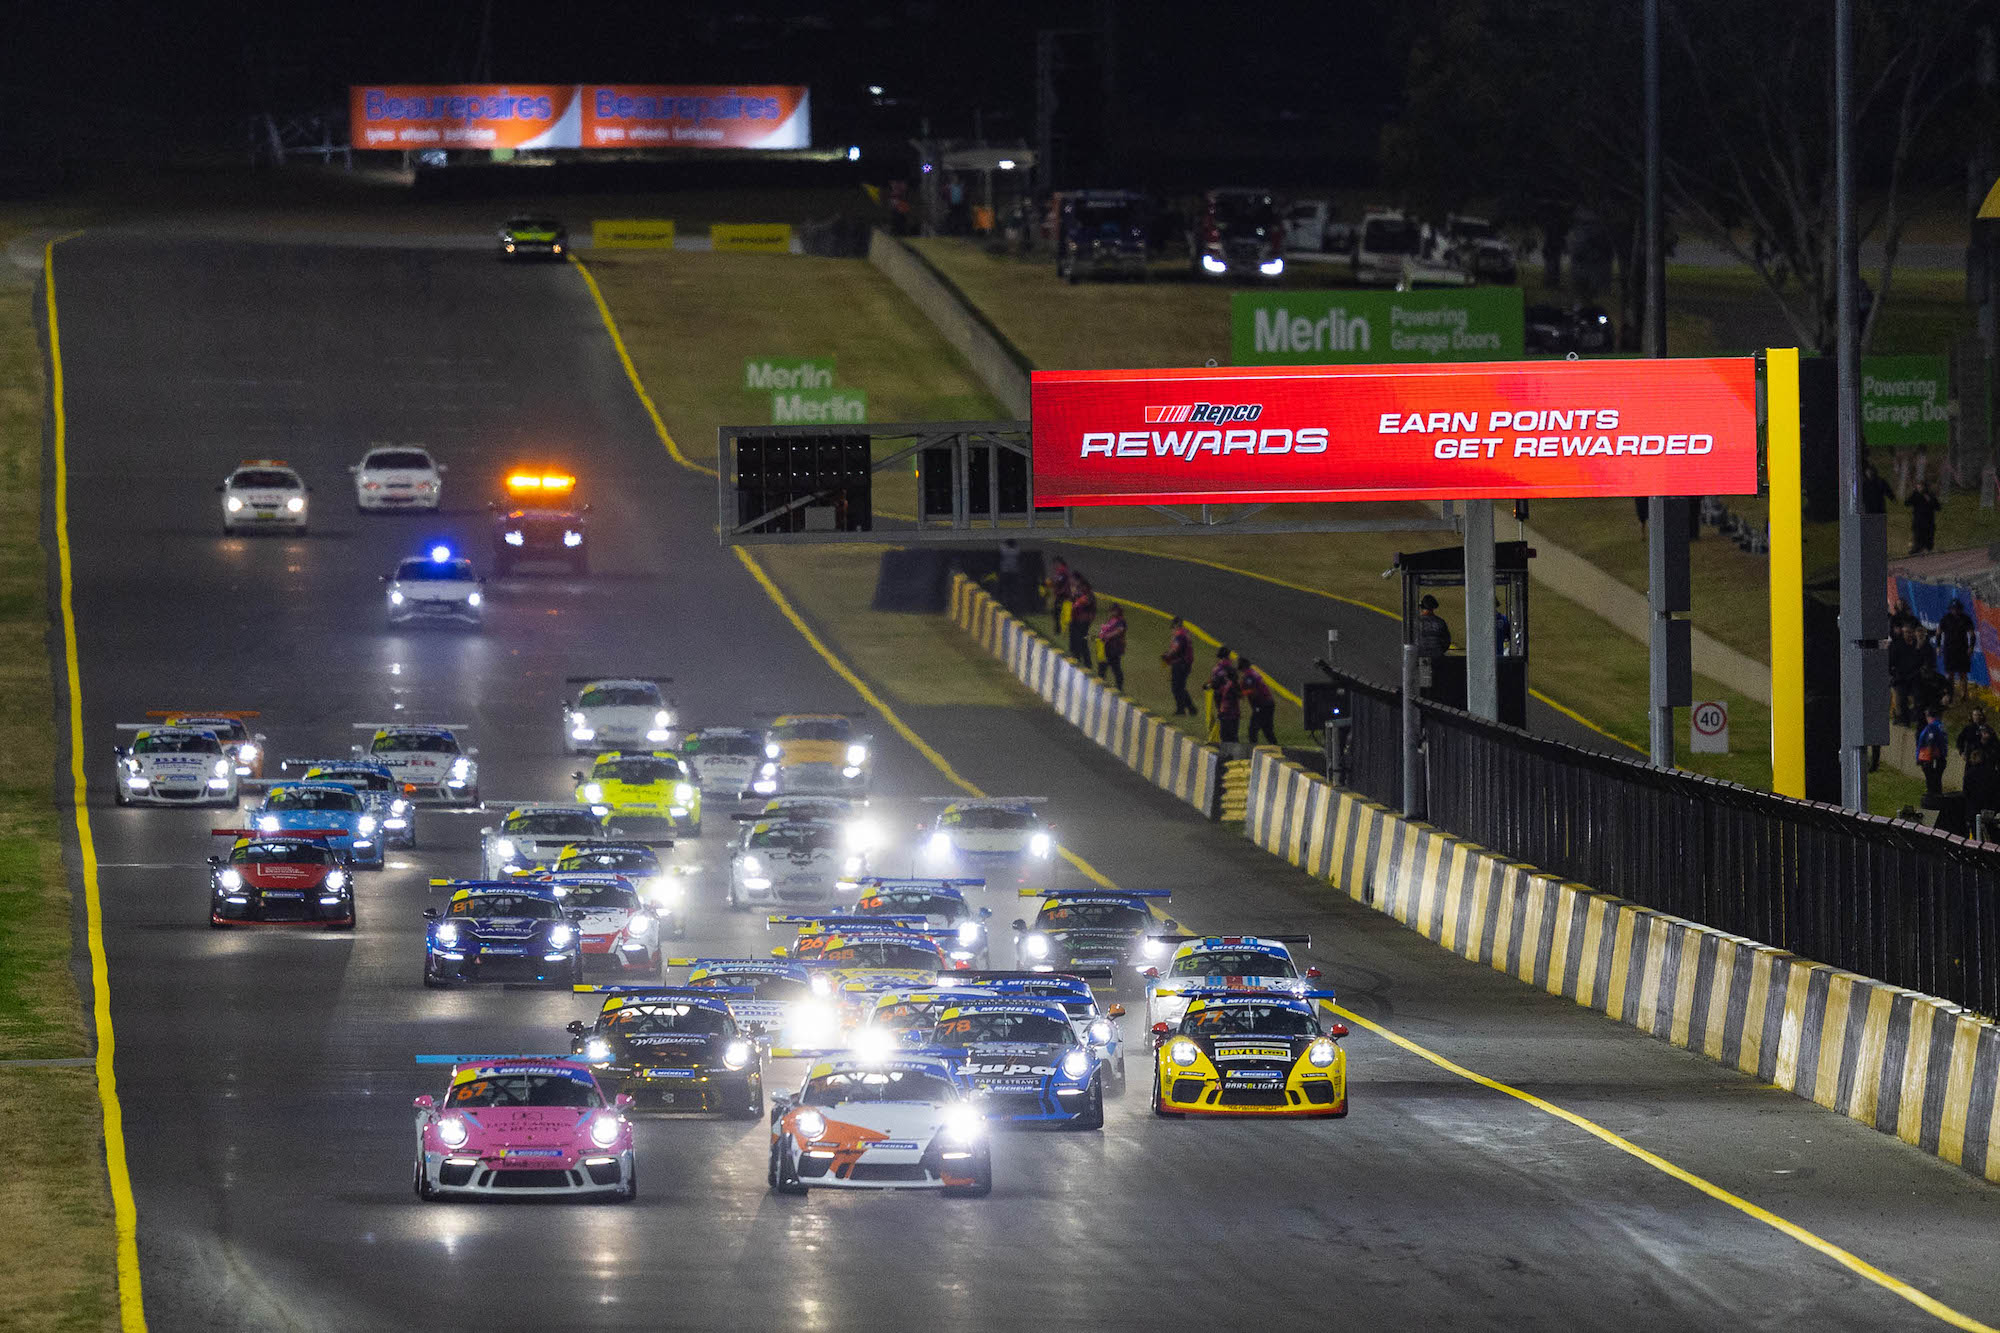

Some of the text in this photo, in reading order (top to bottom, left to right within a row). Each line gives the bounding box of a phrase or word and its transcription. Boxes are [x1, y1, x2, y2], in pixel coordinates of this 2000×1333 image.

[365, 88, 552, 127] Beaurepaires
[595, 88, 780, 127] Beaurepaires
[1254, 307, 1371, 351] Merlin
[1391, 305, 1467, 330] Powering
[1391, 329, 1500, 355] Garage Doors
[747, 363, 833, 389] Merlin
[1863, 376, 1937, 401] Powering
[775, 394, 865, 421] Merlin
[1189, 403, 1262, 426] Repco
[1863, 401, 1920, 427] Garage
[1379, 410, 1619, 434] EARN POINTS
[1080, 428, 1329, 462] REWARDS
[1434, 434, 1713, 459] GET REWARDED
[1700, 711, 1720, 727] 40
[861, 897, 883, 909] 16
[800, 937, 824, 951] 26
[1176, 959, 1198, 971] 13
[645, 996, 709, 1004] MICHELIN
[980, 1006, 1046, 1014] MICHELIN
[1226, 998, 1291, 1006] MICHELIN
[940, 1020, 971, 1036] 78
[500, 1067, 572, 1076] MICHELIN
[456, 1081, 488, 1100] 67
